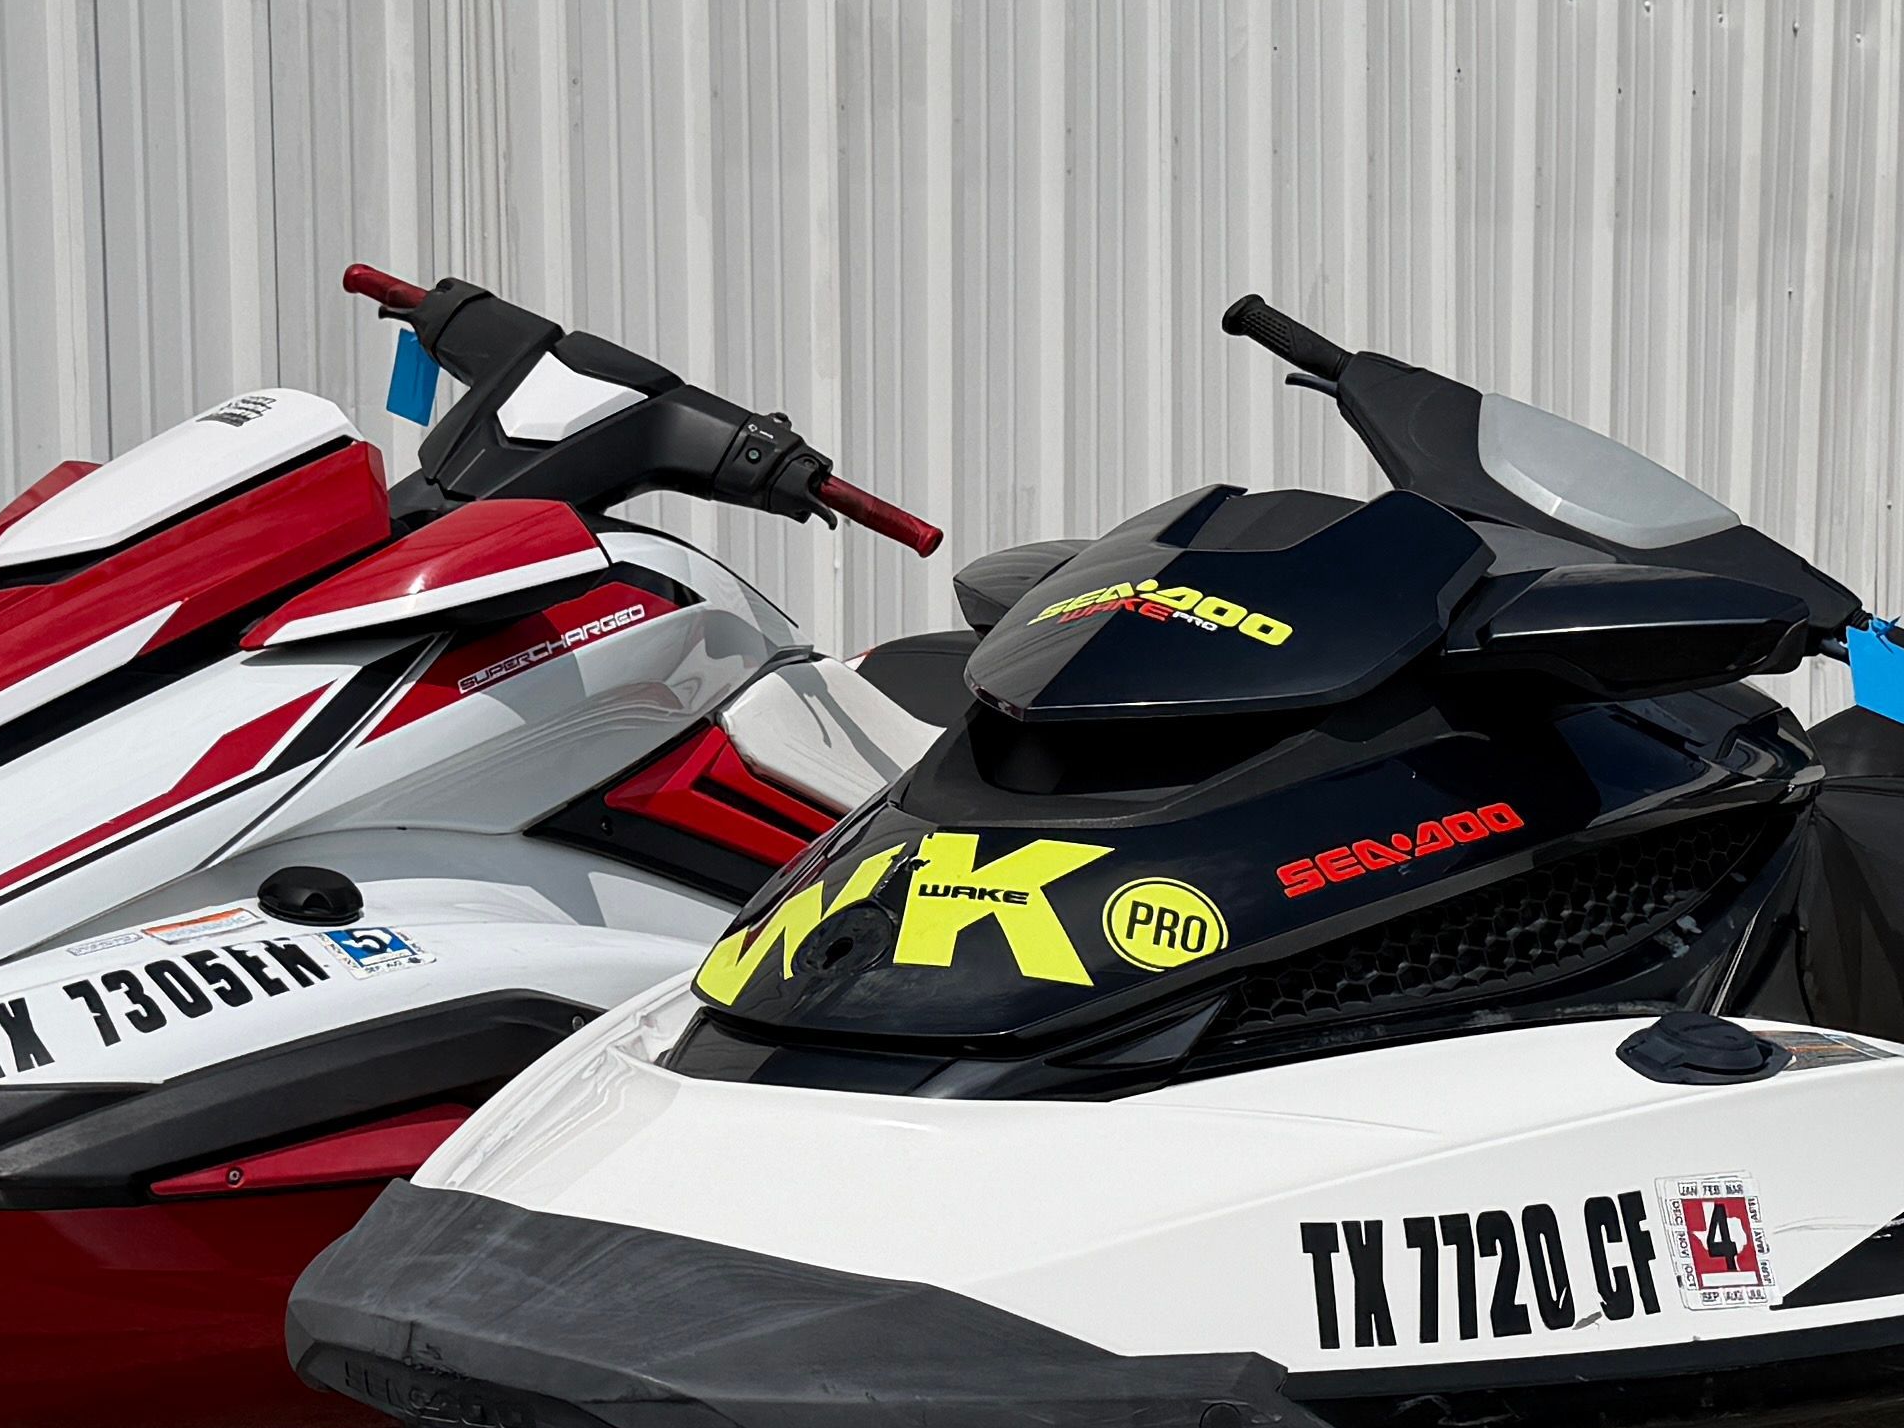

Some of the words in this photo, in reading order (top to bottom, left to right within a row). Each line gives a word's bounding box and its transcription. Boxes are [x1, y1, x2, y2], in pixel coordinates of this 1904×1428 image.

[1057, 598, 1174, 624] WAKE
[1173, 611, 1218, 632] PRO
[458, 604, 645, 694] SUPERCHARGED
[917, 884, 1029, 905] WAKE
[1126, 901, 1207, 953] PRO
[1678, 1231, 1690, 1257] NOV
[1707, 1203, 1738, 1272] 4
[1300, 1220, 1397, 1350] TX
[1403, 1203, 1575, 1343] 7720
[1583, 1190, 1661, 1320] CF
[1685, 1266, 1696, 1287] OCT
